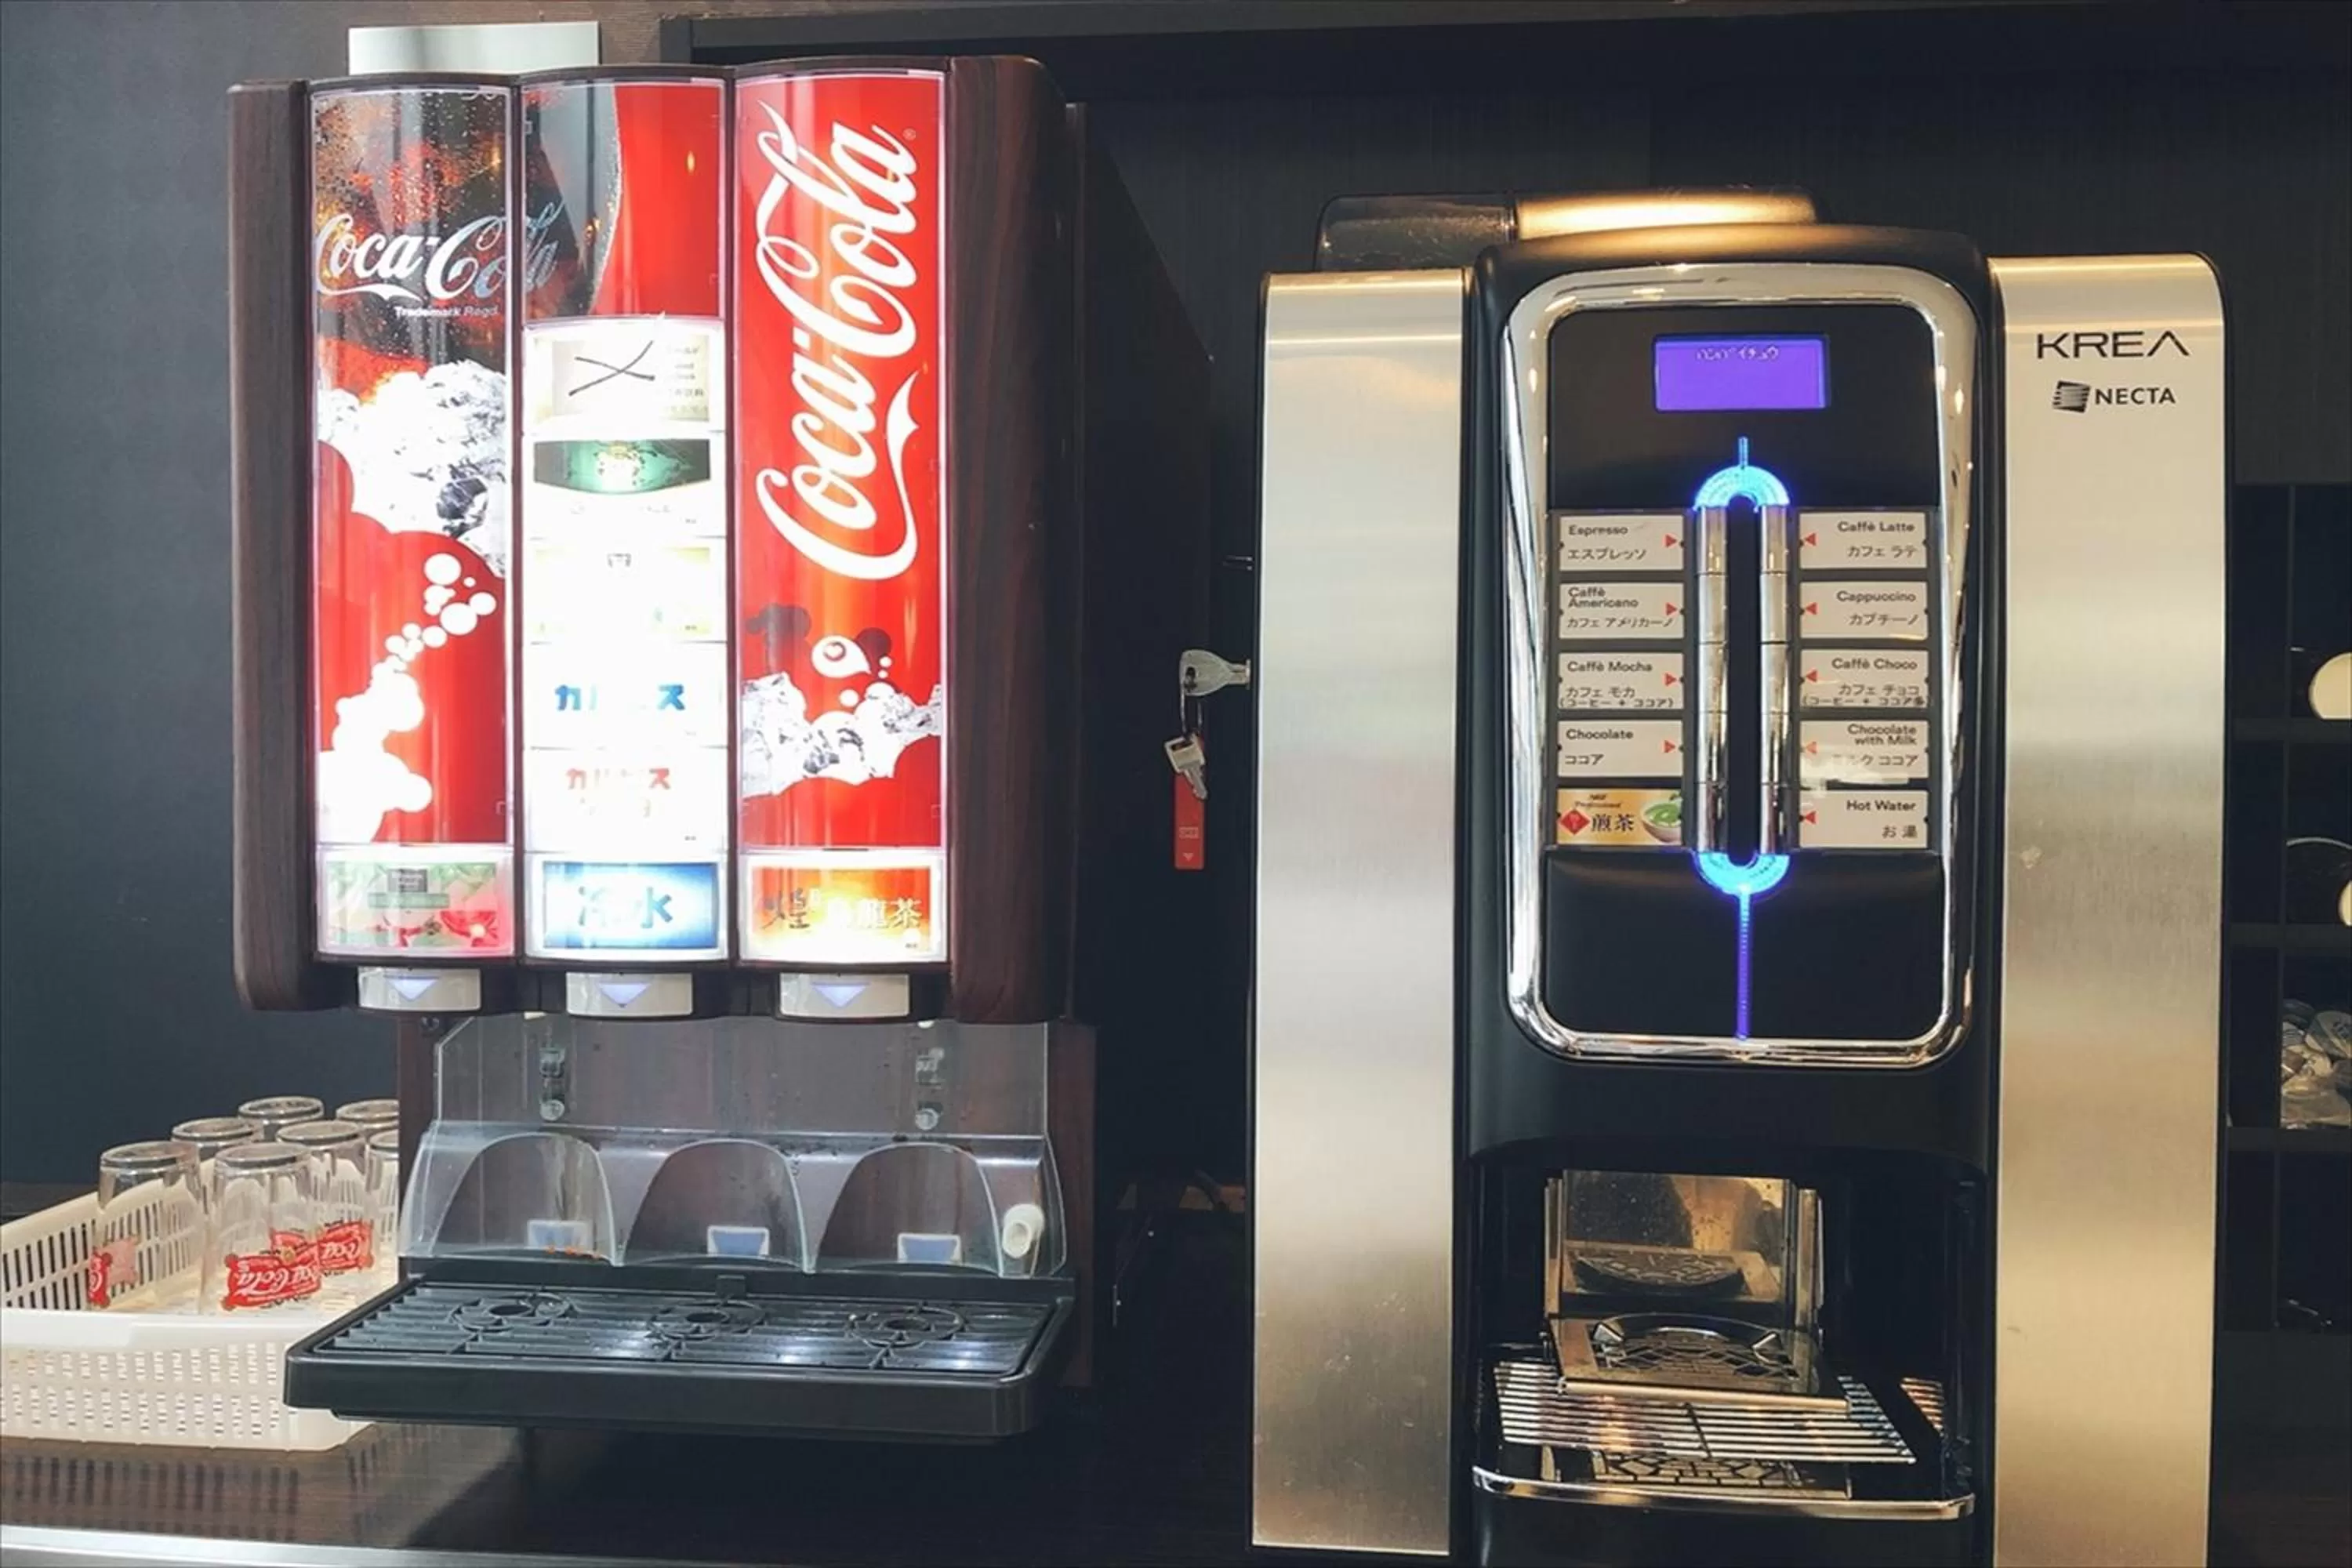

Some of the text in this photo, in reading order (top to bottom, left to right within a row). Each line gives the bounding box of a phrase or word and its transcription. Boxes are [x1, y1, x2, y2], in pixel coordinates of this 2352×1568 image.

[756, 100, 916, 580] Coca-Cola
[2037, 330, 2190, 359] KREA
[2095, 387, 2176, 405] NECTA
[1569, 524, 1628, 537] Espresso
[1879, 521, 1915, 532] Latte
[1568, 546, 1646, 560] エスプレッソ
[1847, 546, 1918, 557] カフェ ラテ
[1568, 597, 1639, 608] Americano
[1836, 590, 1917, 603] Cappuccino
[1568, 616, 1674, 628] カフェ アメリカーノ
[1849, 614, 1919, 626] カプチーノ
[1608, 661, 1653, 672] Mocha
[1874, 658, 1918, 670] Choco
[1566, 687, 1636, 699] カフェ モカ
[1838, 684, 1920, 696] カフェ チョコ
[1566, 728, 1634, 739] Chocolate
[1847, 723, 1917, 735] Chocolate
[1855, 735, 1918, 746] with Milk
[1565, 753, 1605, 765] ココア
[1878, 753, 1919, 768] ココア
[1846, 799, 1917, 811] Hot Water
